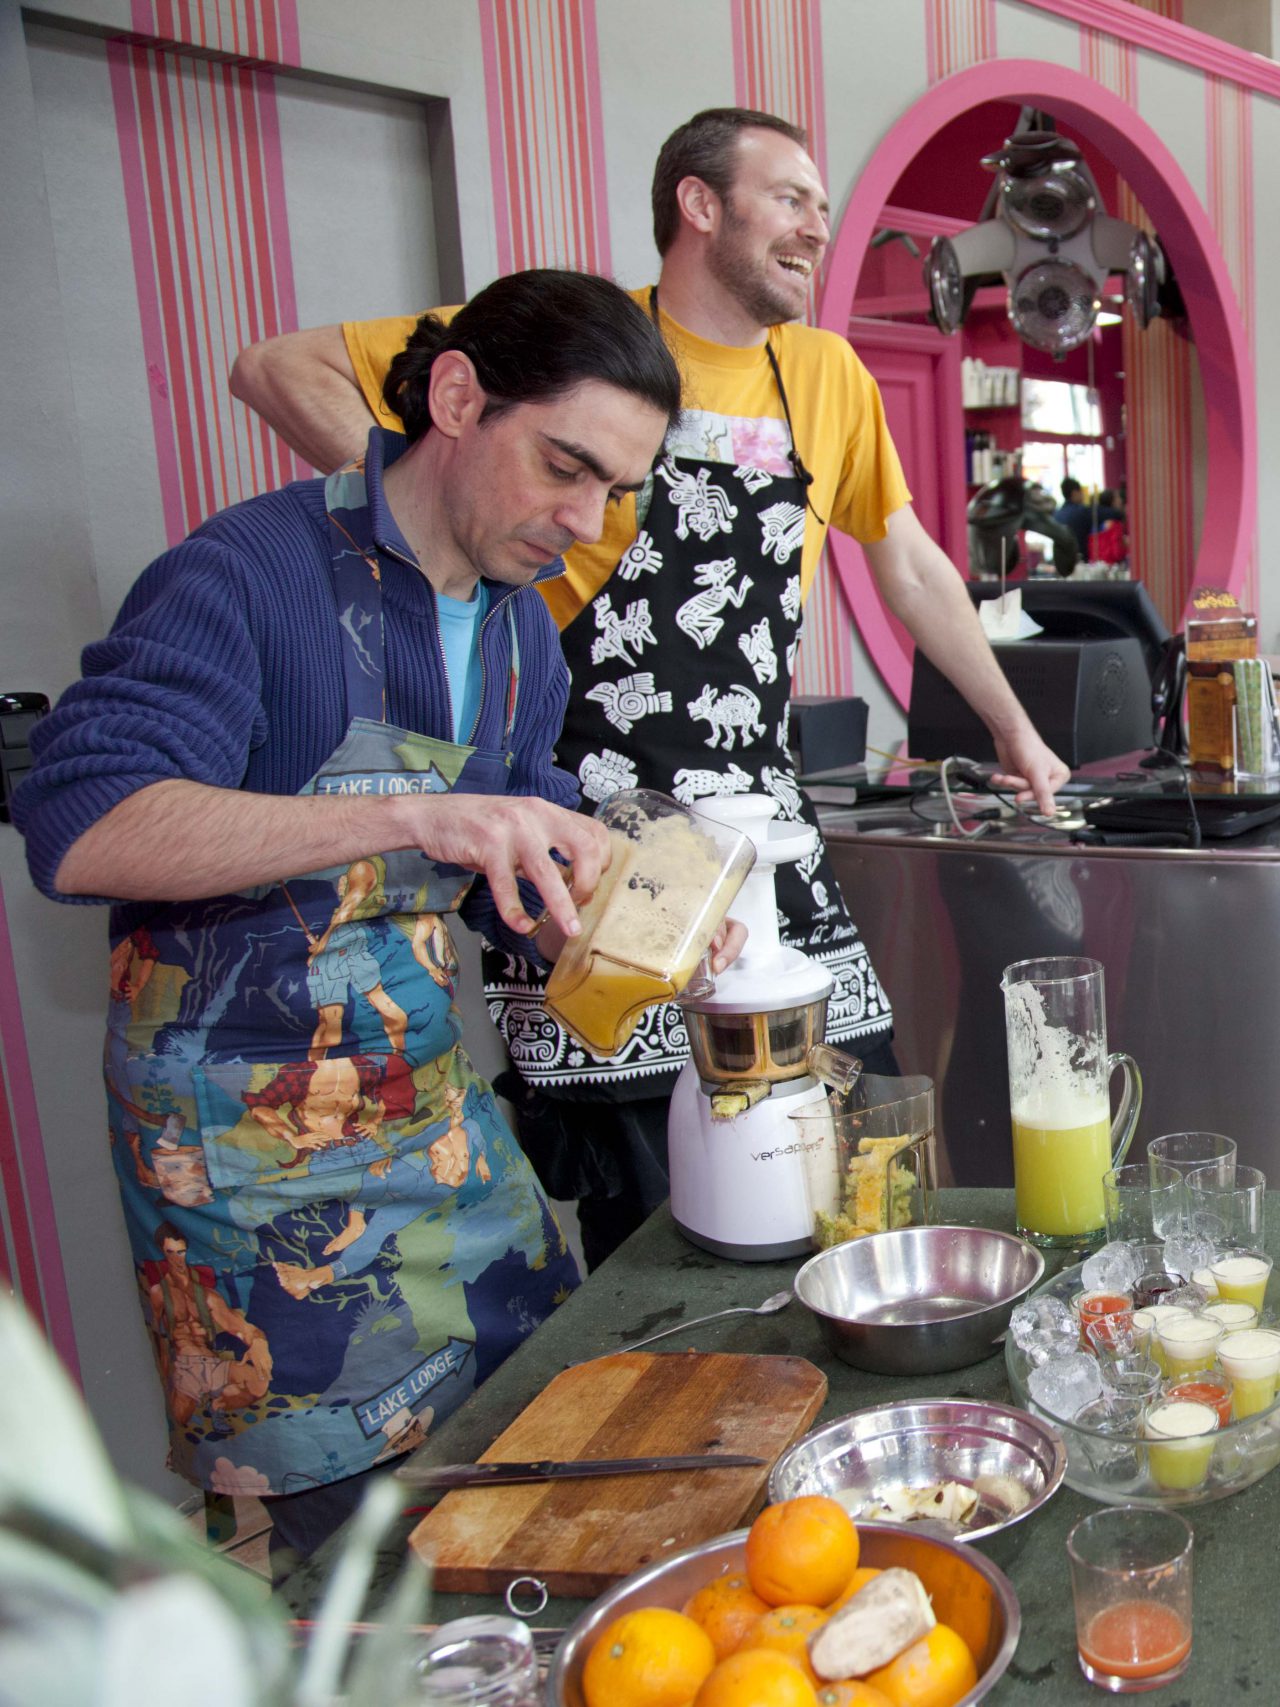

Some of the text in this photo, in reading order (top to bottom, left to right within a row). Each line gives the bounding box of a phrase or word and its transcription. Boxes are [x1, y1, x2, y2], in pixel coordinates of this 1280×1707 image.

[378, 777, 432, 796] LODGE
[365, 1350, 456, 1425] LAKE LODGE
